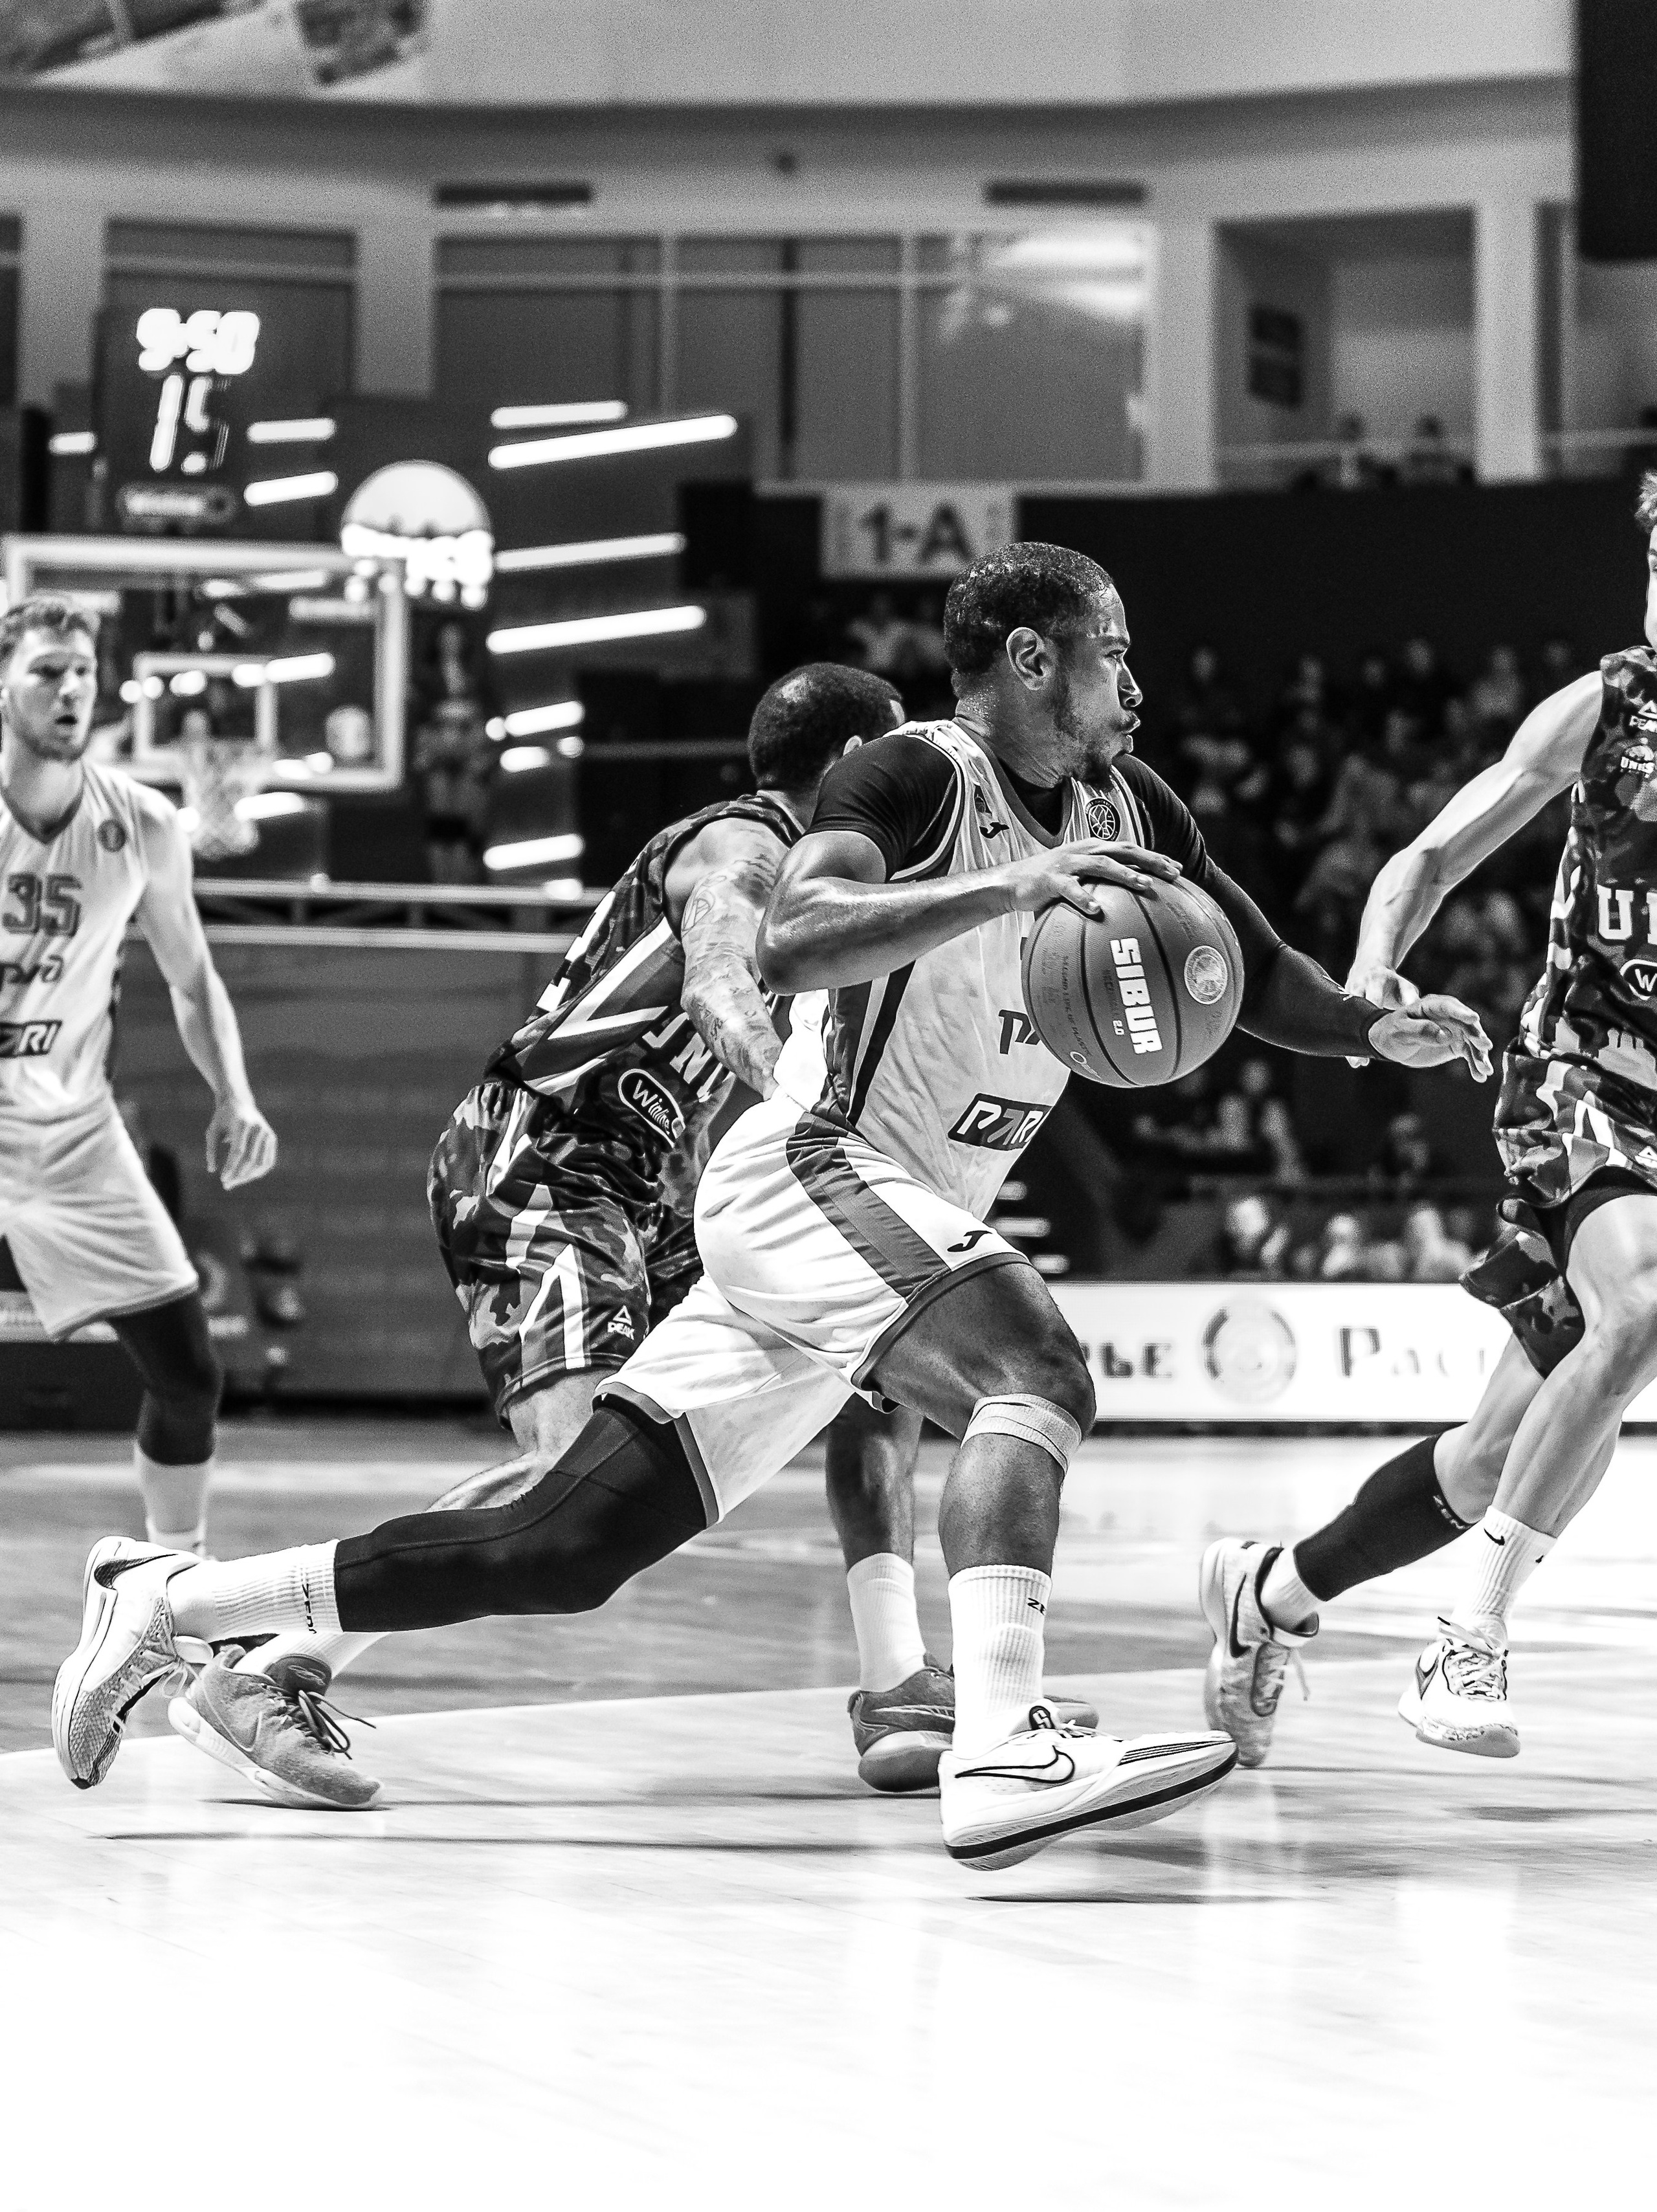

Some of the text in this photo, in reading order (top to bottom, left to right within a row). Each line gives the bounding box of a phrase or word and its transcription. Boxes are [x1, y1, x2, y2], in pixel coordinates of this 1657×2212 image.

[860, 502, 972, 564] 1-A
[3, 872, 83, 938] 35
[1110, 938, 1162, 1054] SIBUR
[1112, 1020, 1125, 1035] 2.0
[607, 1321, 635, 1340] PEAK
